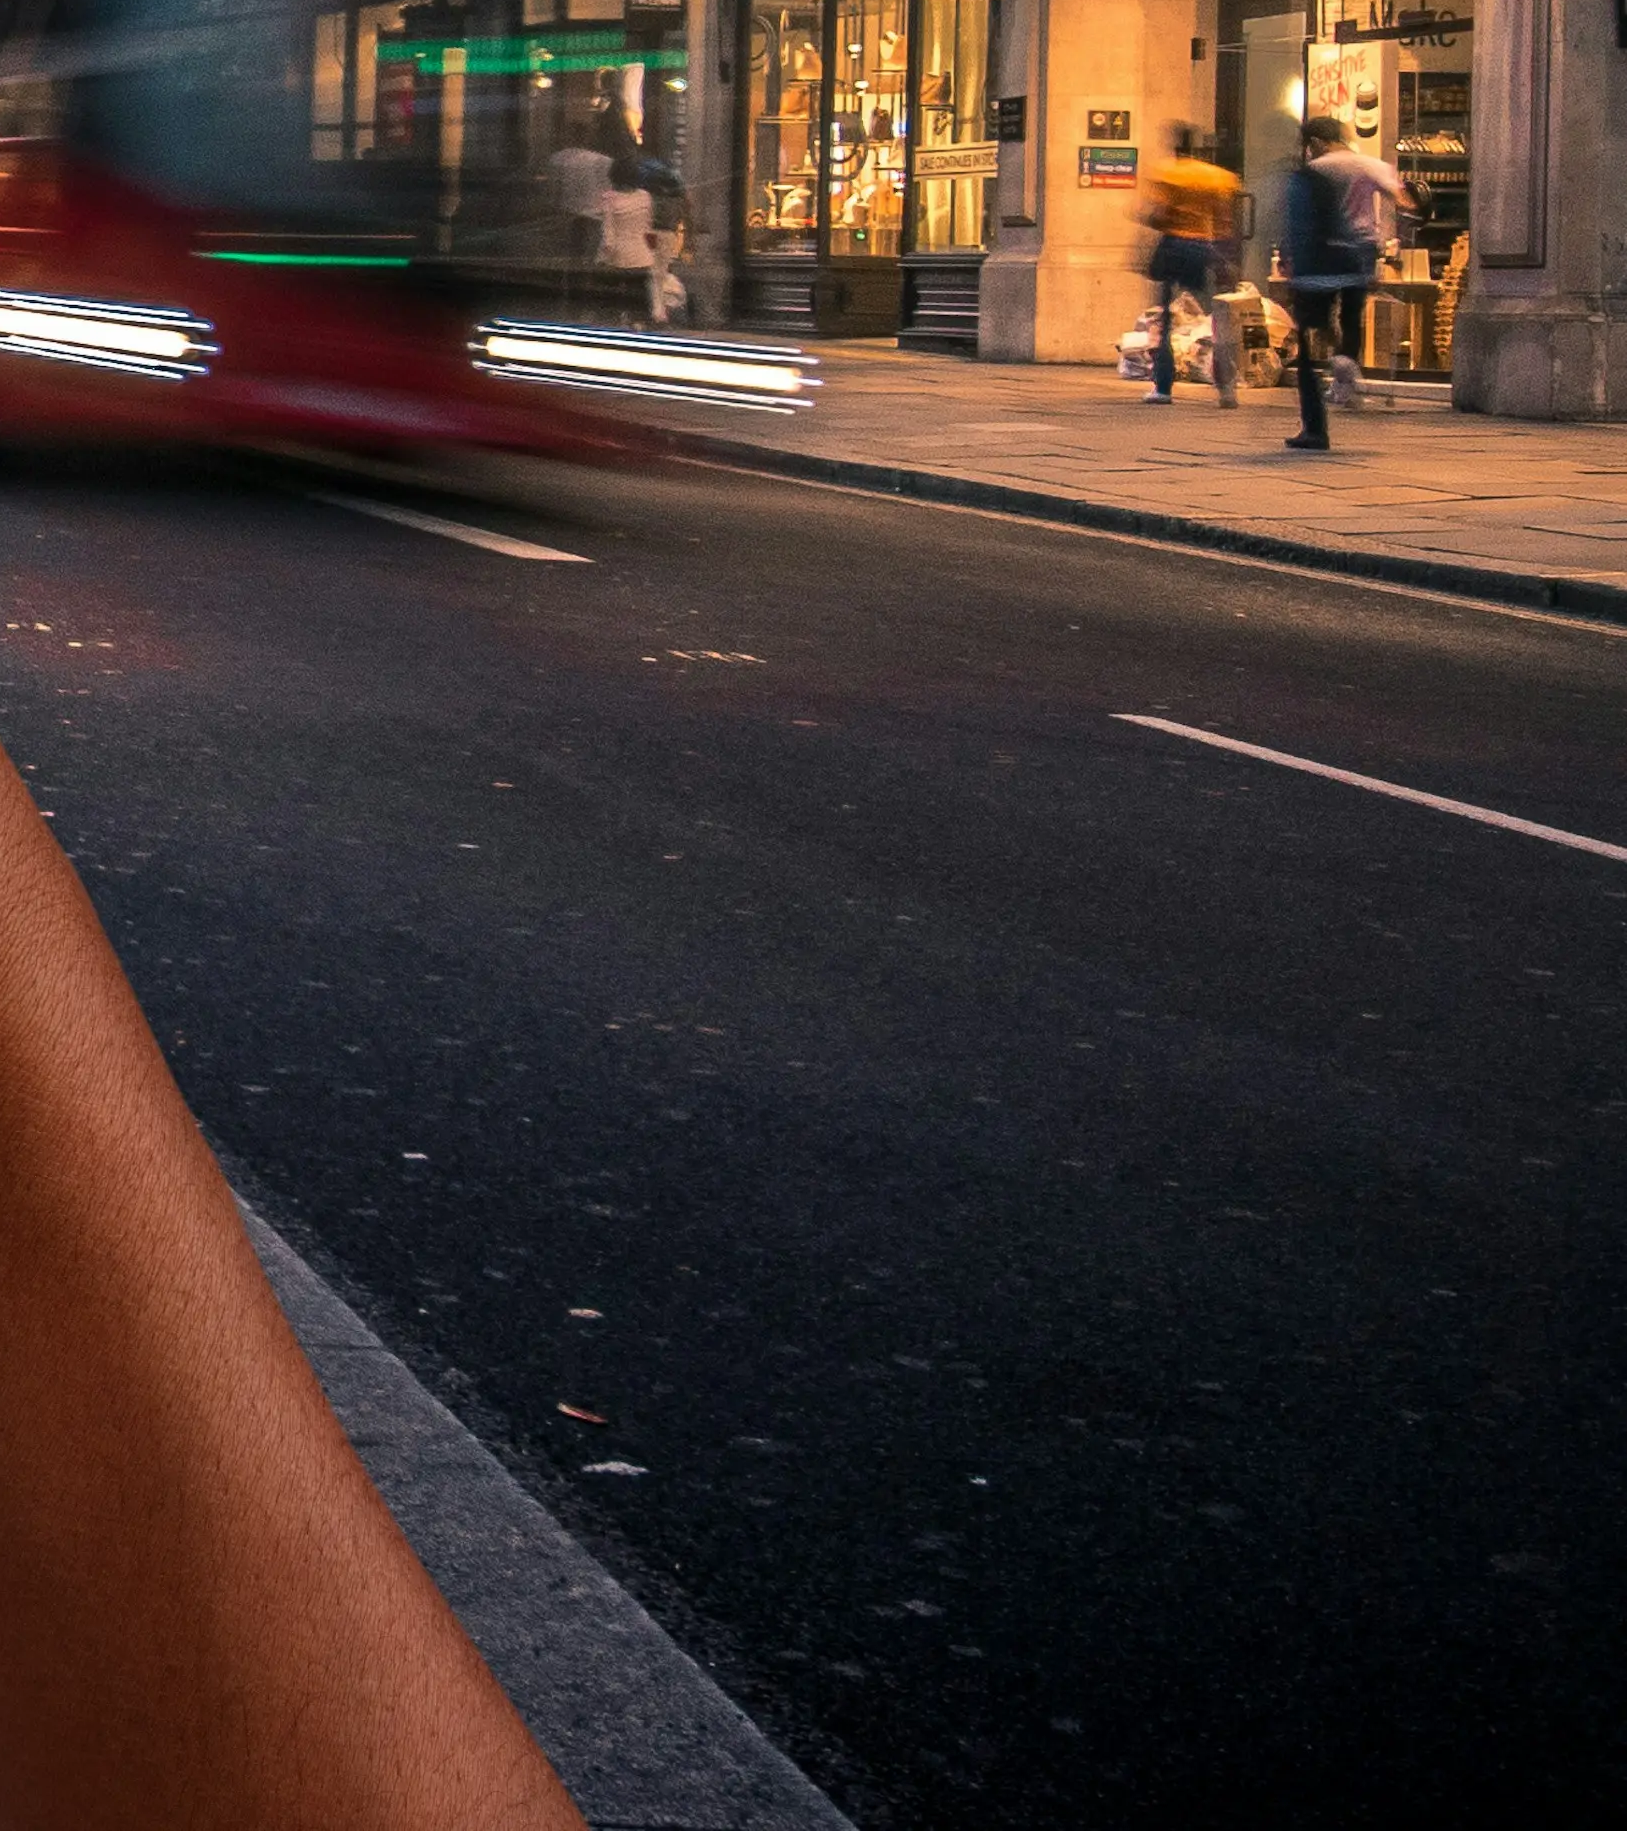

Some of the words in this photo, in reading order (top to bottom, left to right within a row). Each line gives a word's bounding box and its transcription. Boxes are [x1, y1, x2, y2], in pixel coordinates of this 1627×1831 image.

[1310, 49, 1367, 89] SENSITIVE
[1319, 78, 1350, 110] SKIN
[920, 156, 934, 170] SALE
